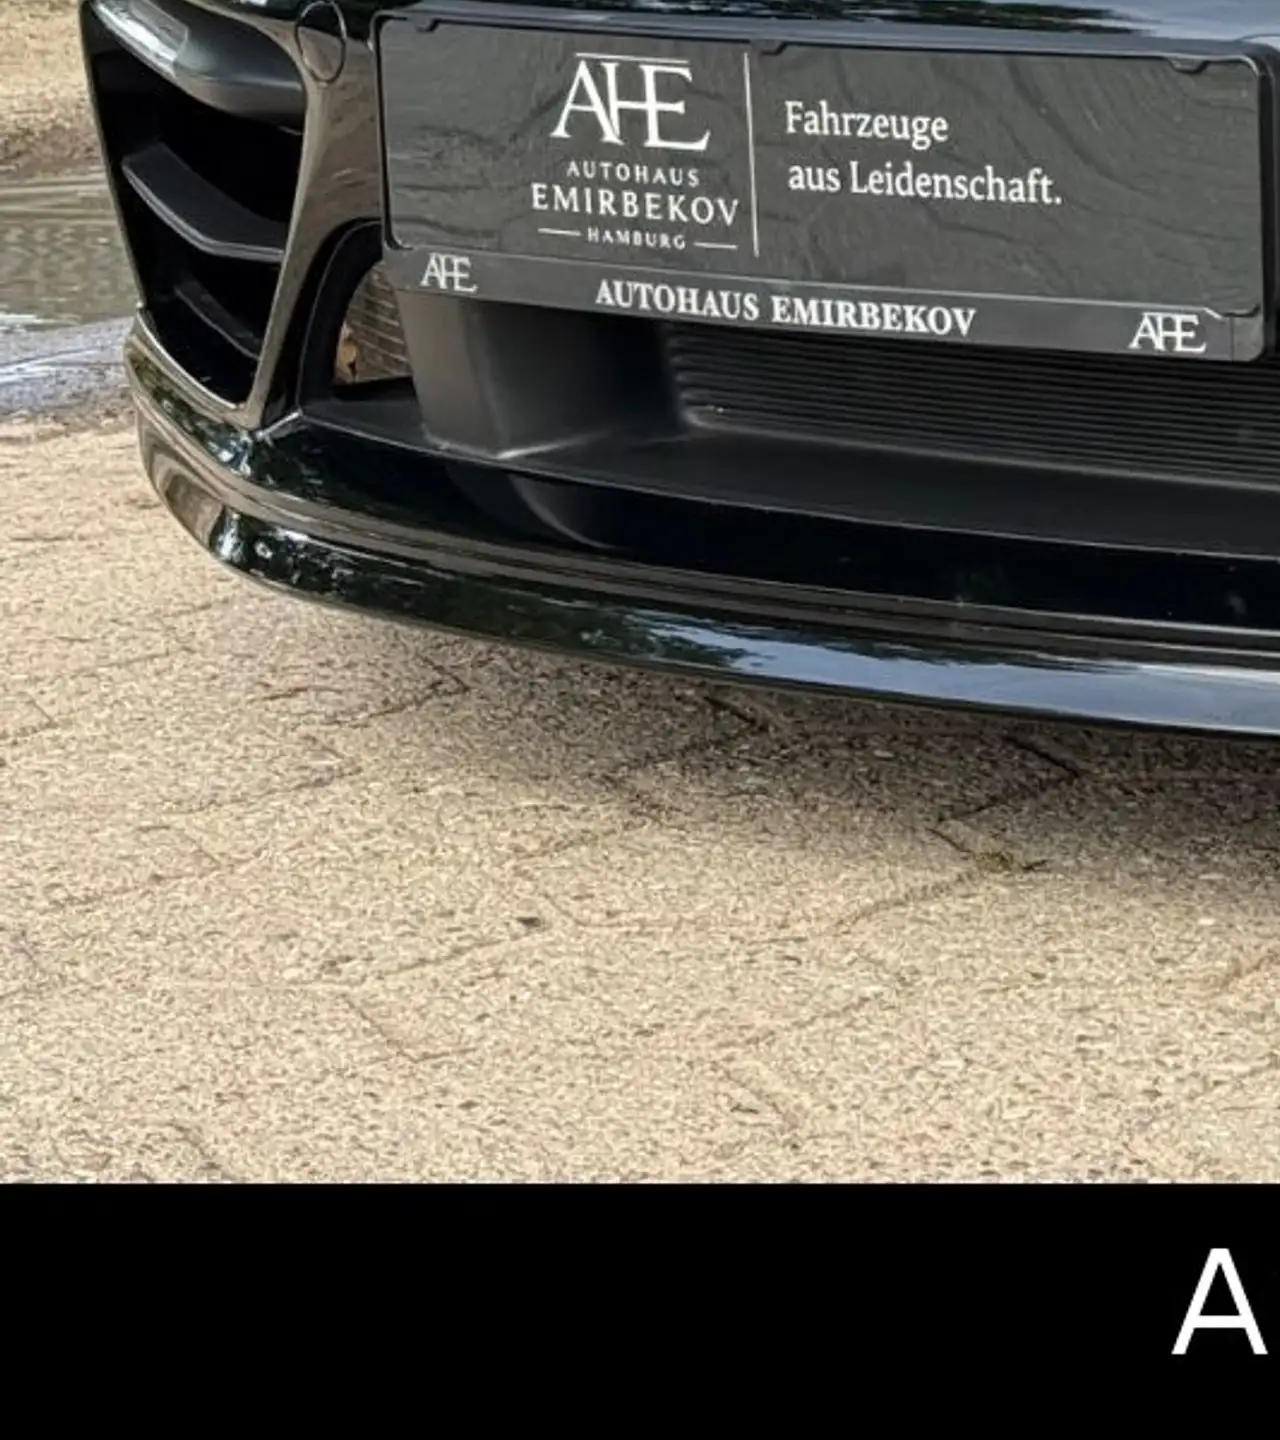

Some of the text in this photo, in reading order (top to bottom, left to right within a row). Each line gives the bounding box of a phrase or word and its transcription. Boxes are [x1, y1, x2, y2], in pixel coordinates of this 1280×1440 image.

[549, 59, 712, 151] AHE
[785, 99, 949, 150] Fahrzeuge
[566, 160, 700, 188] AUTOHAUS
[788, 160, 1062, 205] aus Leidenschaft.
[531, 182, 739, 227] EMIRBEKOV
[587, 227, 687, 250] HAMBURG
[420, 251, 478, 293] AHE
[595, 278, 976, 337] AUTOHAUS EMIRBEKOV
[1128, 312, 1206, 353] AHE
